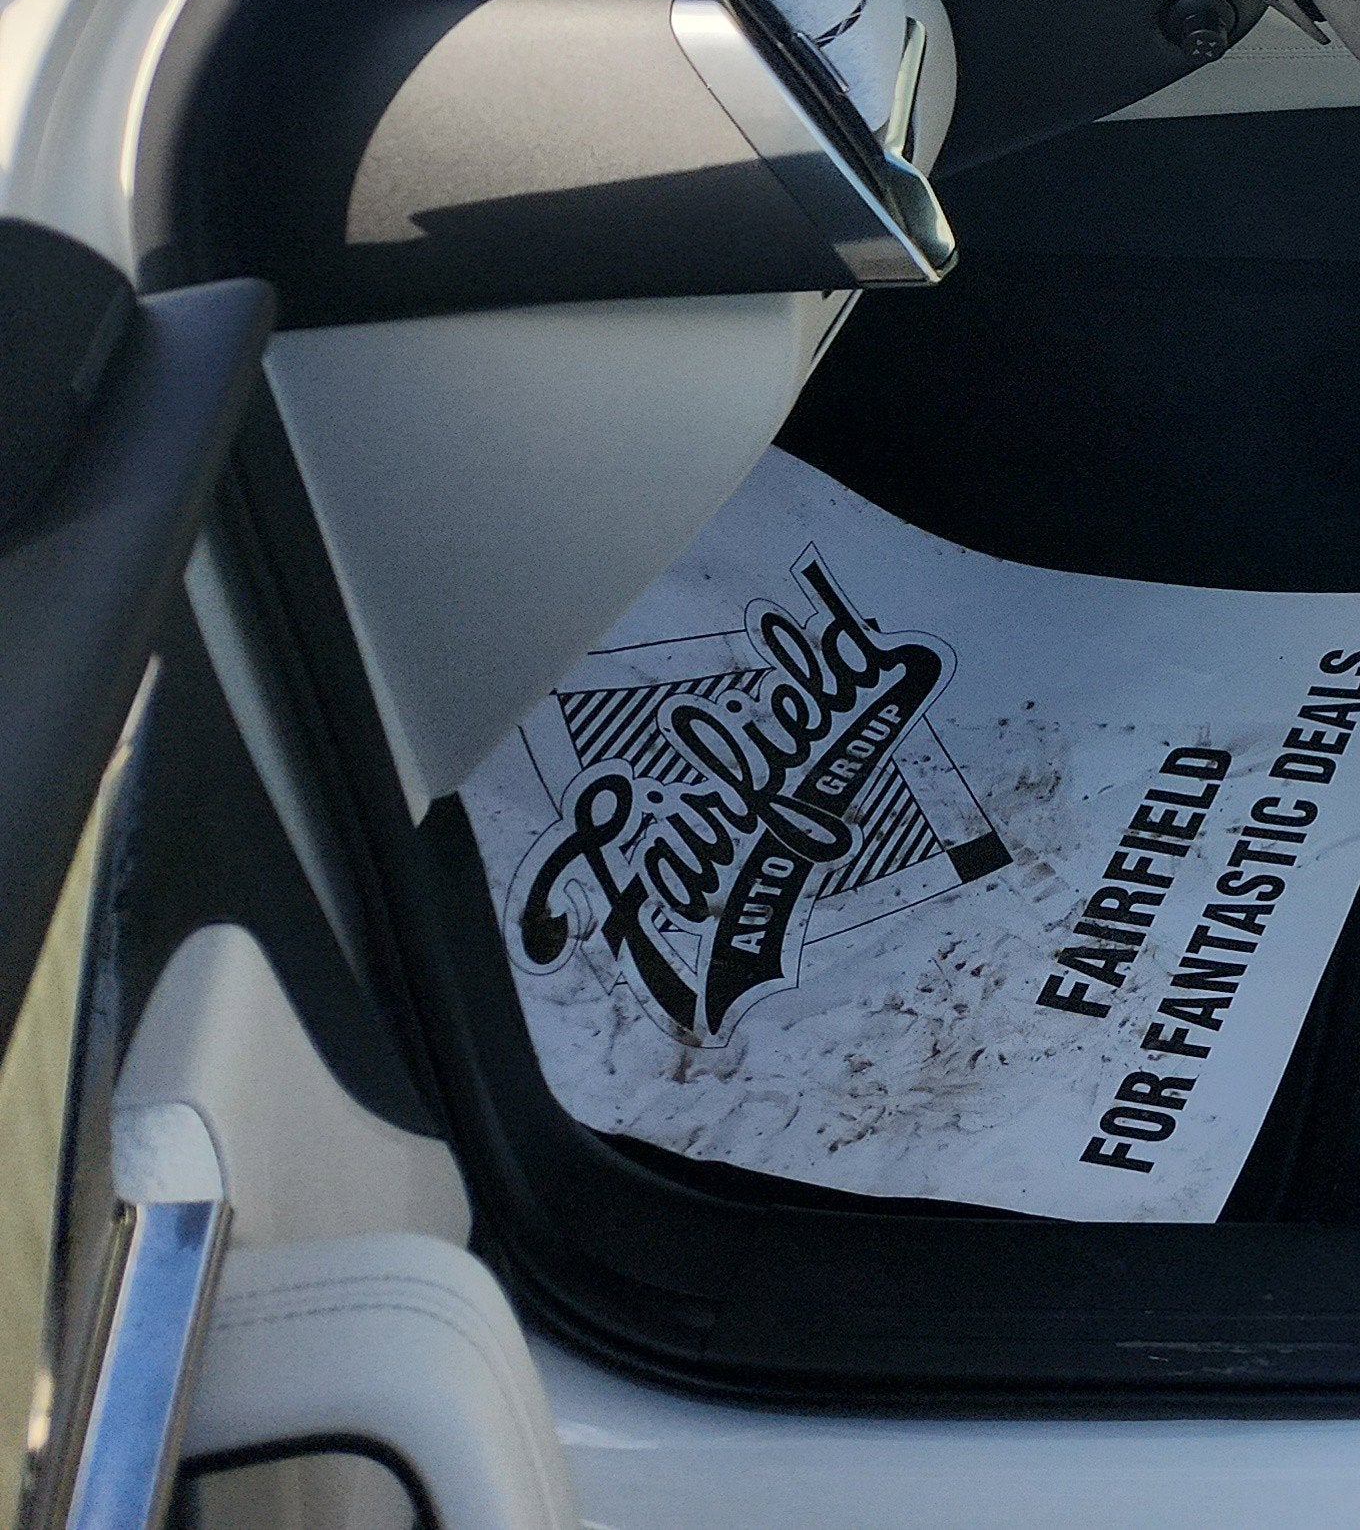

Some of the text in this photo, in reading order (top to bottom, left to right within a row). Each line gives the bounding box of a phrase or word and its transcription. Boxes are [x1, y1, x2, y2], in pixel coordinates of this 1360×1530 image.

[521, 560, 942, 1032] Fairfield
[731, 703, 904, 955] AUTO GROUP
[1035, 745, 1234, 1019] FAIRFIELD
[1139, 796, 1319, 1060] FANTASTIC
[1079, 1070, 1200, 1174] FOR
